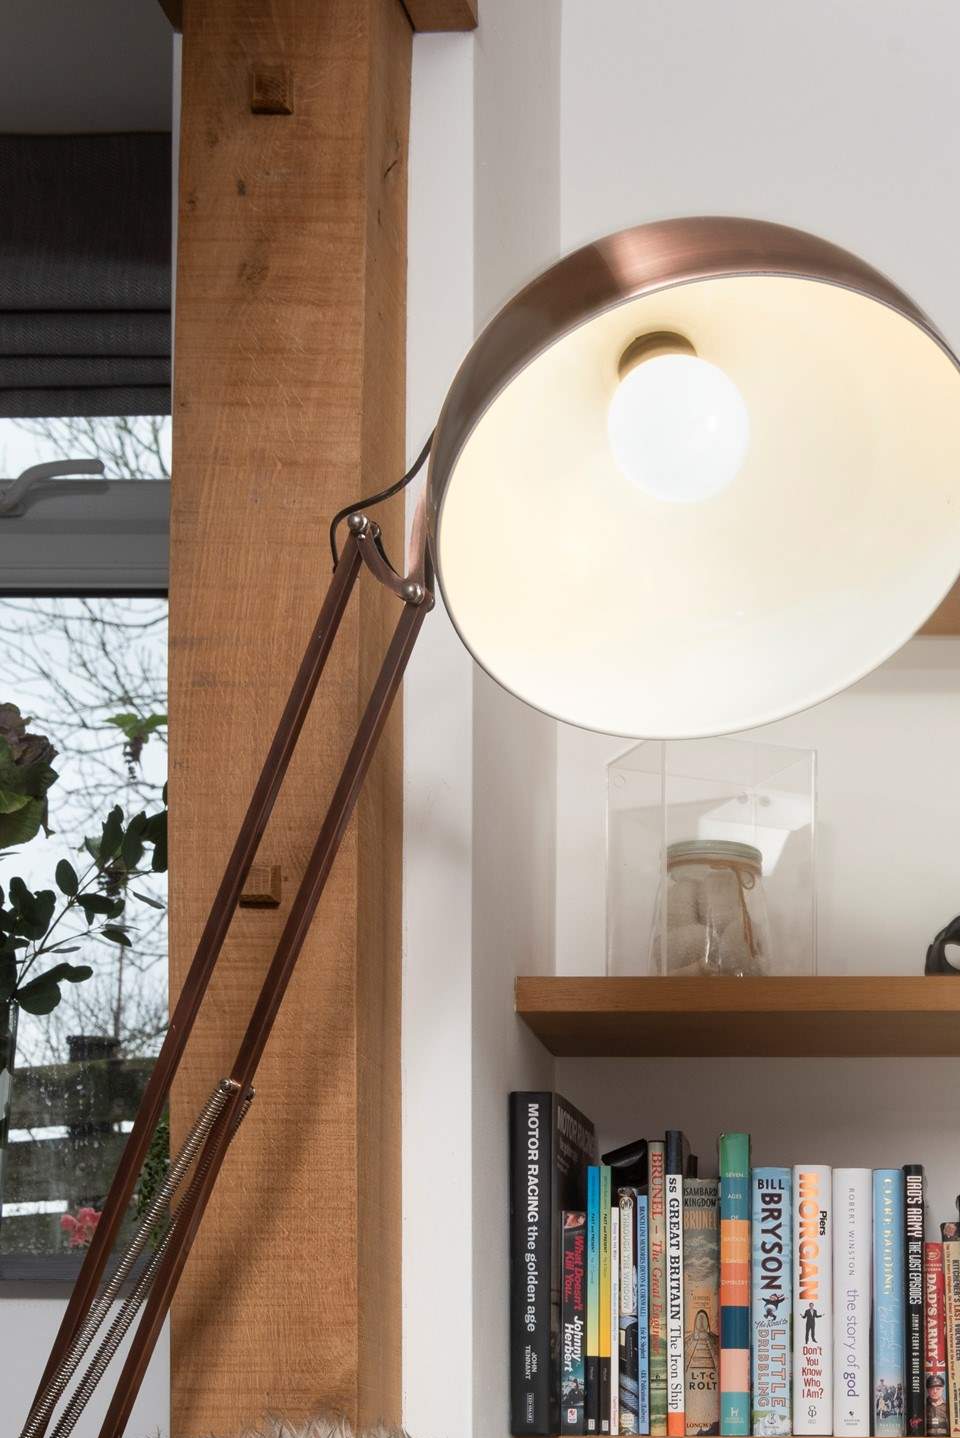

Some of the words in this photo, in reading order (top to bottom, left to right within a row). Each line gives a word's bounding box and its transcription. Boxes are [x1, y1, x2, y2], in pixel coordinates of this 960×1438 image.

[528, 1103, 539, 1161] MOTOR
[528, 1165, 539, 1223] RACING
[757, 1178, 785, 1190] BILL
[528, 1225, 538, 1250] the
[669, 1198, 679, 1250] GREAT
[799, 1173, 820, 1301] MORGAN
[819, 1211, 827, 1236] Piers
[760, 1192, 783, 1290] BRYSON
[525, 1253, 538, 1302] golden
[670, 1255, 681, 1321] BRITAIN
[926, 1272, 938, 1316] DAD'S
[952, 1260, 960, 1303] KITCHENER'S
[847, 1289, 859, 1311] the
[525, 1306, 537, 1332] age
[843, 1316, 857, 1350] story
[564, 1322, 574, 1373] Herbert
[573, 1315, 584, 1362] Johnny
[671, 1325, 682, 1350] The
[927, 1316, 939, 1361] ARMY
[671, 1353, 682, 1379] Iron
[757, 1329, 770, 1408] DRIBBLING
[771, 1329, 787, 1408] LITTLE
[801, 1367, 822, 1377] Know
[806, 1357, 819, 1367] You
[847, 1354, 861, 1370] of
[667, 1383, 682, 1410] Ship
[689, 1382, 718, 1391] ROLT
[803, 1378, 821, 1388] Who
[843, 1372, 860, 1398] god
